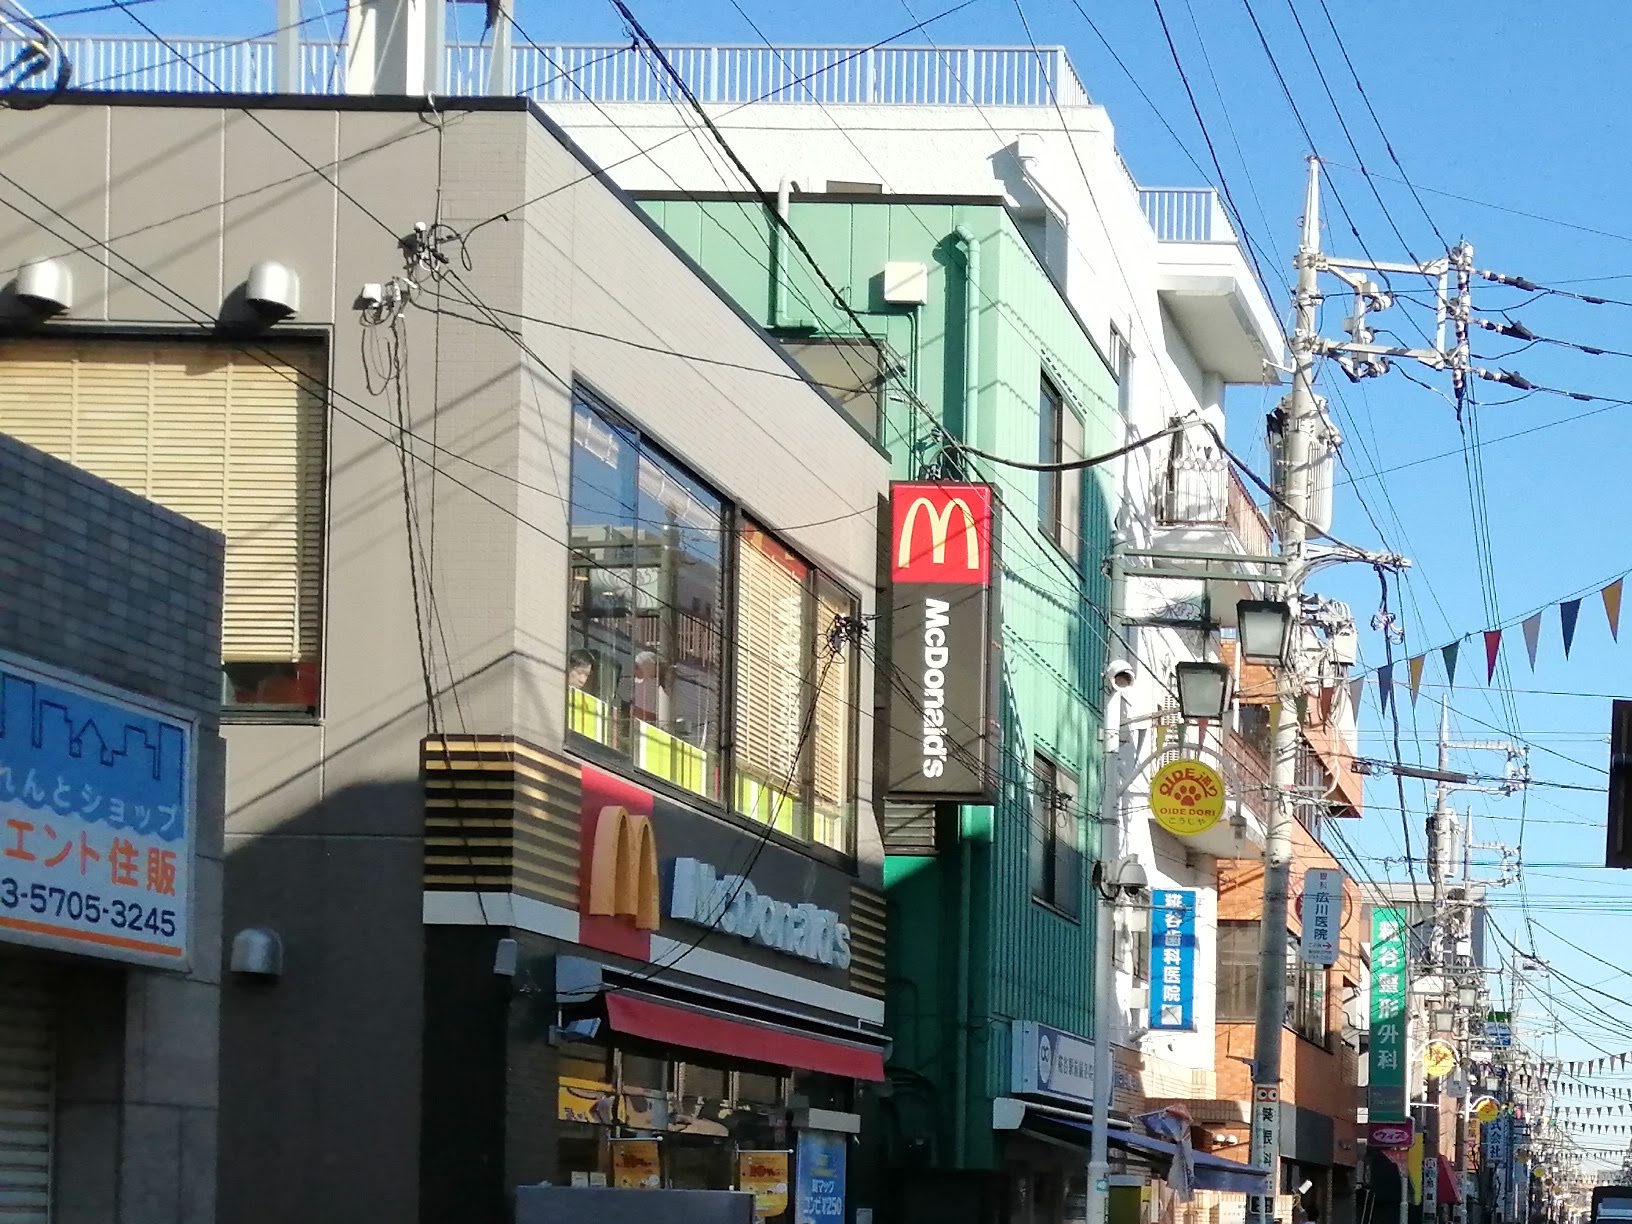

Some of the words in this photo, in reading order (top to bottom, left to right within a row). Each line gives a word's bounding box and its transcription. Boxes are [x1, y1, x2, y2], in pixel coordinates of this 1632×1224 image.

[922, 599, 950, 779] McDonald's
[1160, 807, 1186, 815] OIDE
[1189, 808, 1215, 816] DORI
[1168, 817, 1207, 825] こうじや
[1314, 892, 1330, 941] 広川医院
